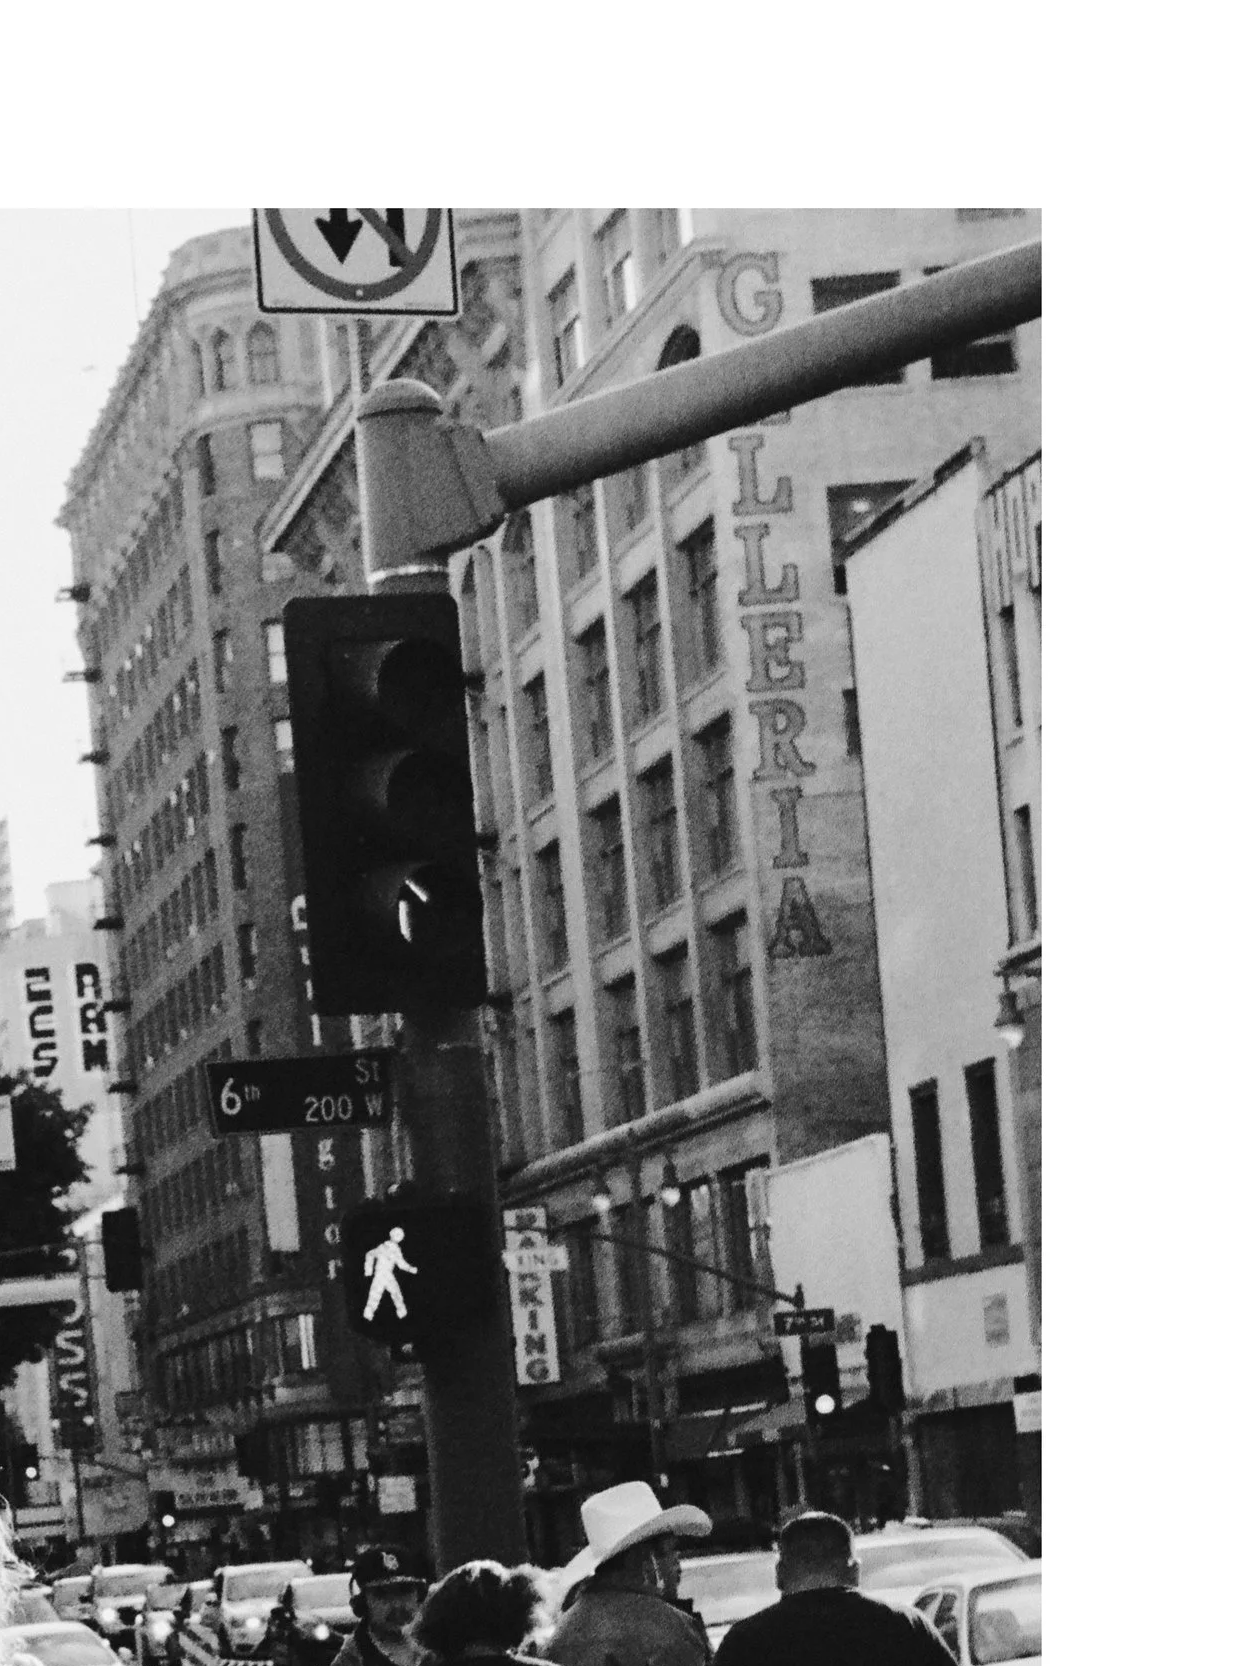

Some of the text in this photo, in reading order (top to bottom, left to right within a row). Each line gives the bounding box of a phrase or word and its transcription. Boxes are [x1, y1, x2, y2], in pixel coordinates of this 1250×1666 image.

[715, 251, 833, 958] GLLERIA
[220, 1058, 380, 1116] 6th St
[304, 1091, 383, 1123] 200 W
